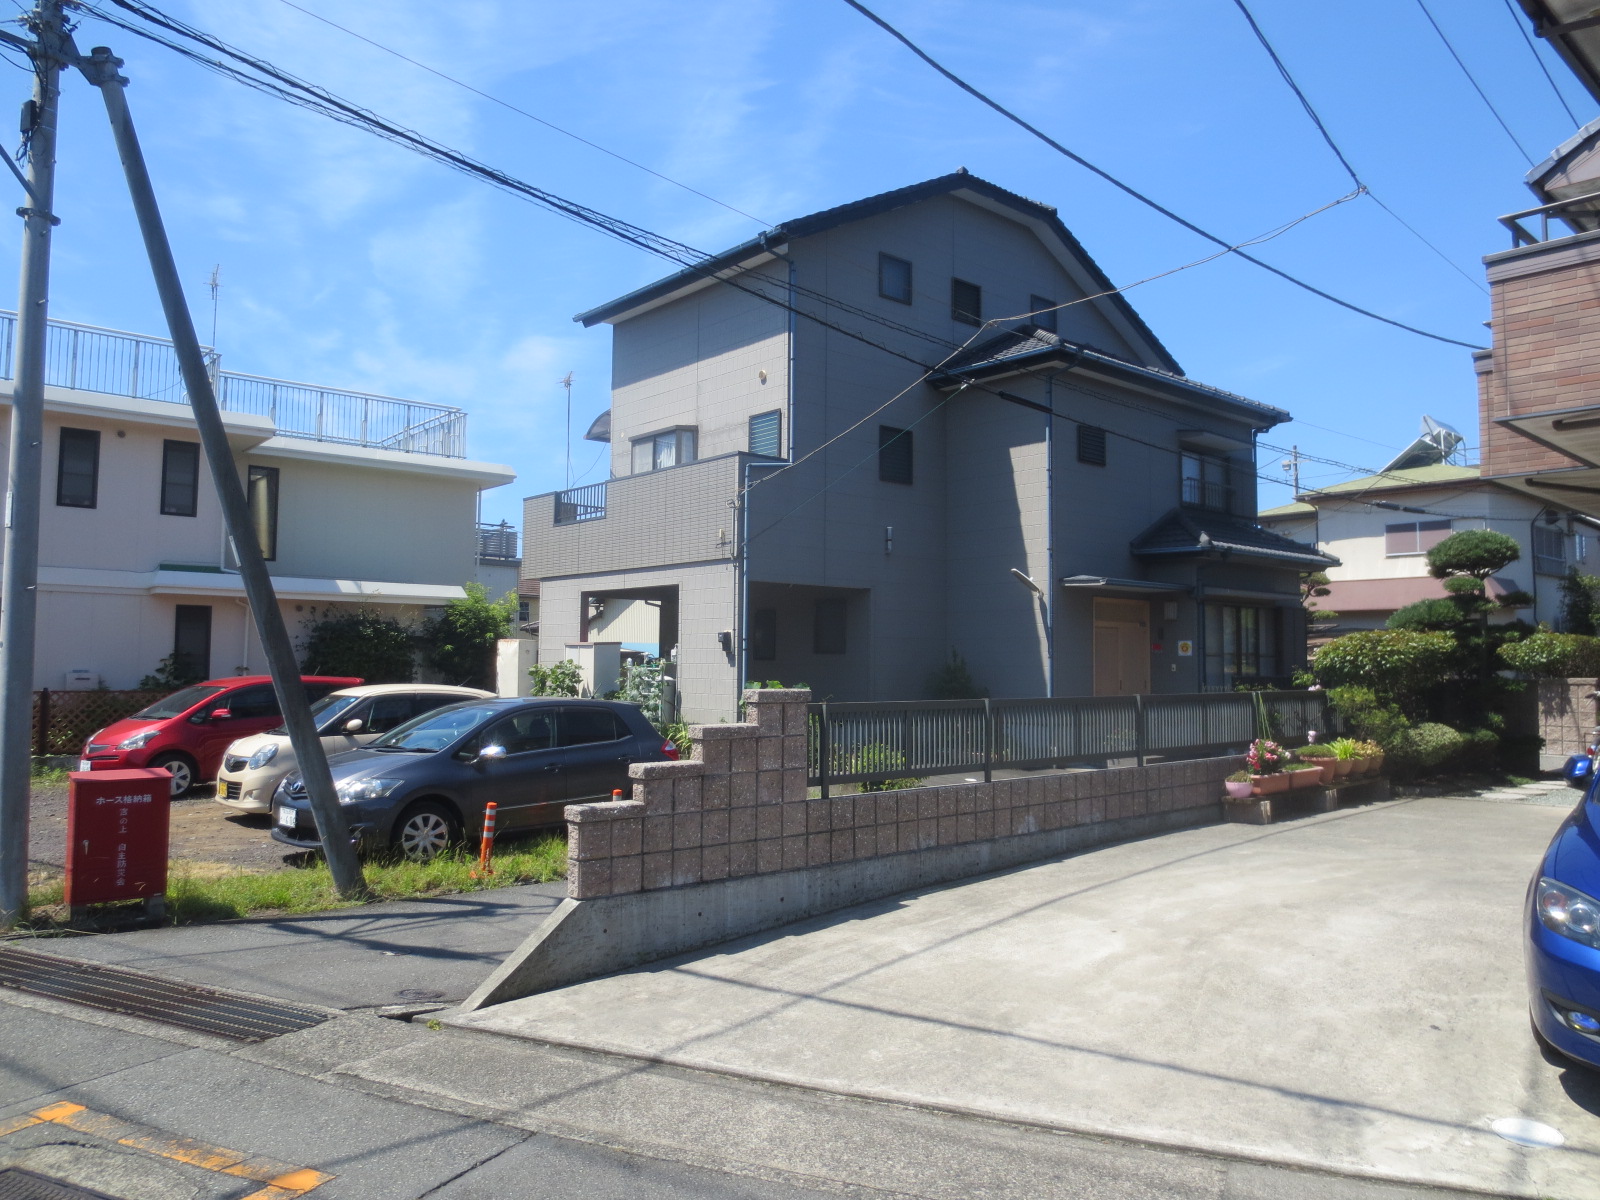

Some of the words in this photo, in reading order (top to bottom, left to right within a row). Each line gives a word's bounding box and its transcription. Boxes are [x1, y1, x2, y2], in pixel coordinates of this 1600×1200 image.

[96, 794, 152, 805] ホース格納箱
[116, 843, 127, 886] 自主防災会
